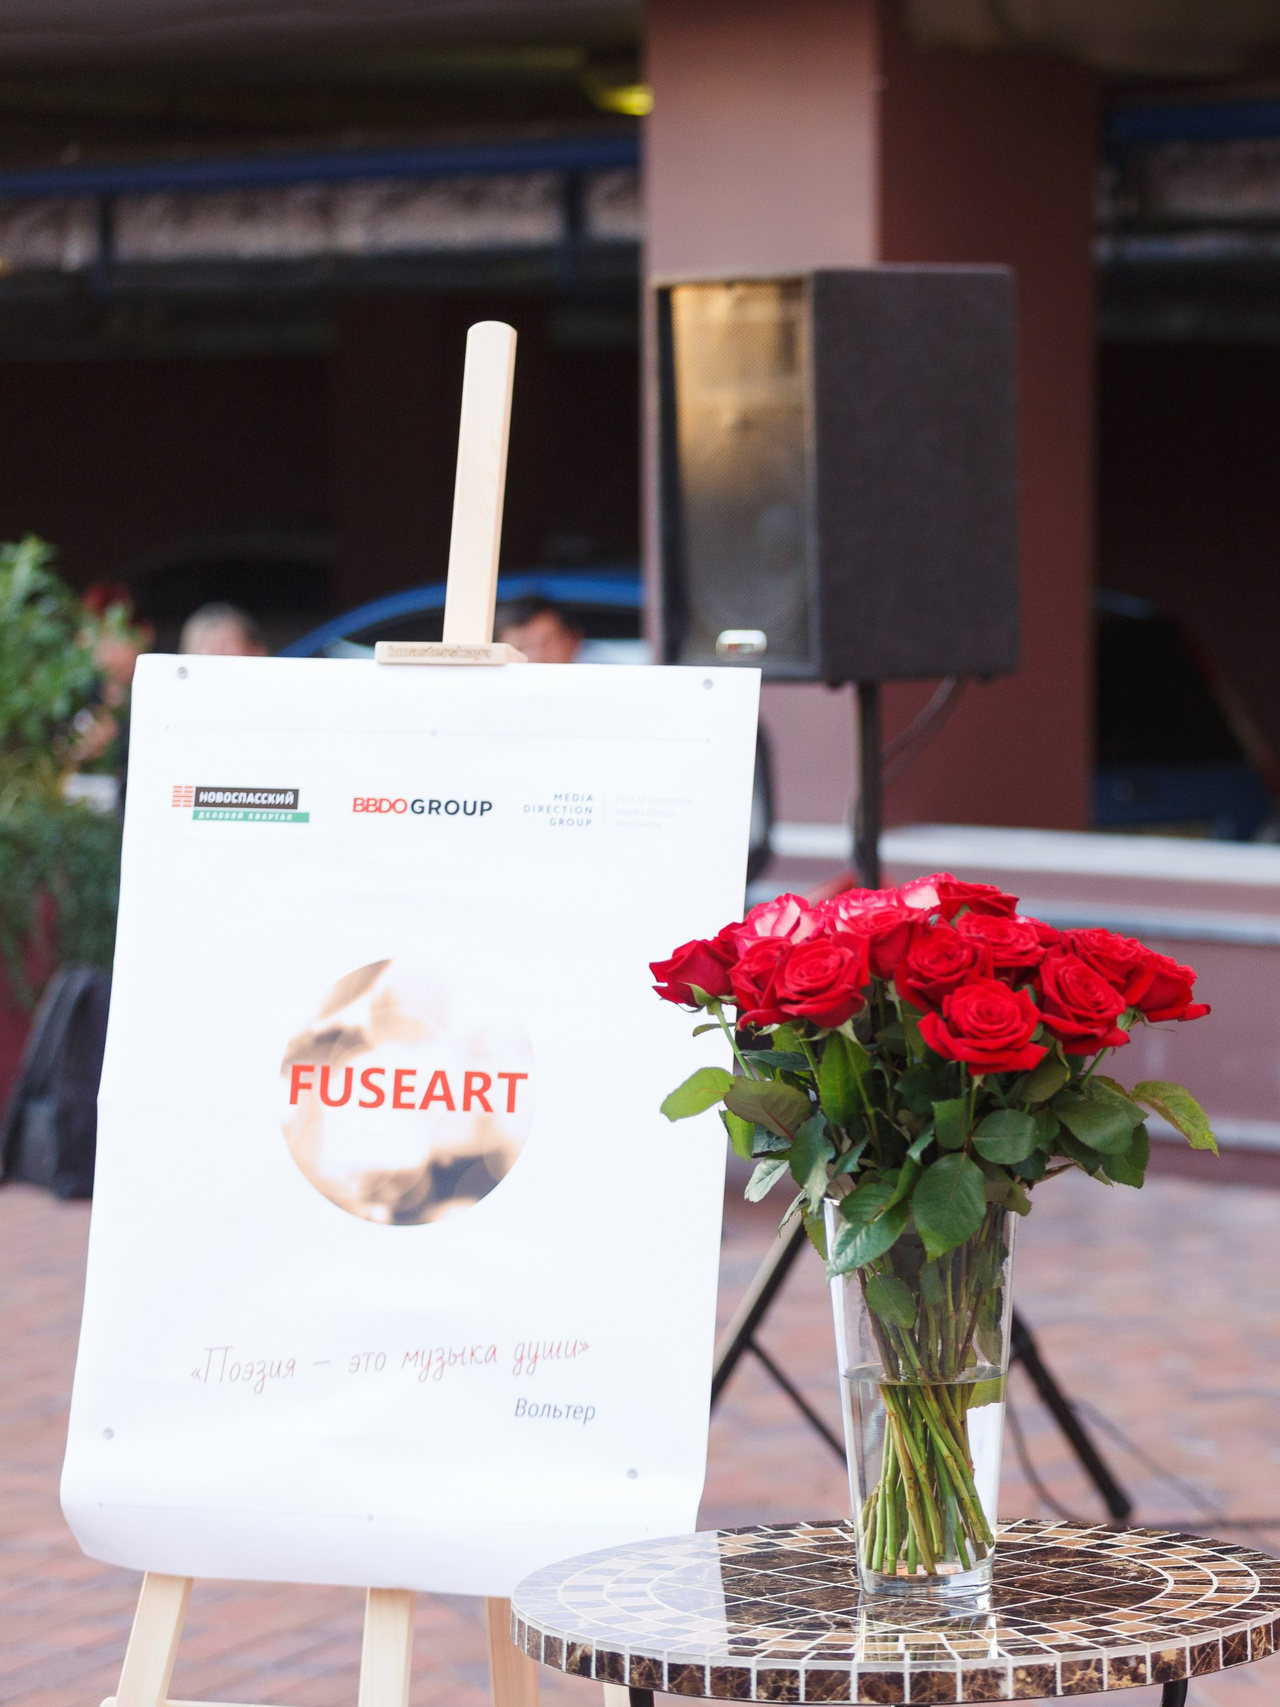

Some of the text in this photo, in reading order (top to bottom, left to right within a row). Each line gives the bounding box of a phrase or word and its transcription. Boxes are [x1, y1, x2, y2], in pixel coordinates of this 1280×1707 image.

[199, 790, 295, 805] НОВОСПАССКИЙ
[553, 793, 594, 802] MEDIA
[523, 804, 593, 815] DIRECTION
[549, 818, 593, 827] GROUP
[289, 1064, 529, 1114] FUSEART
[191, 1345, 297, 1395] «Поэзия
[348, 1351, 387, 1374] это
[401, 1344, 498, 1382] музыка
[512, 1338, 590, 1377] души»
[514, 1397, 597, 1425] Вольтер
